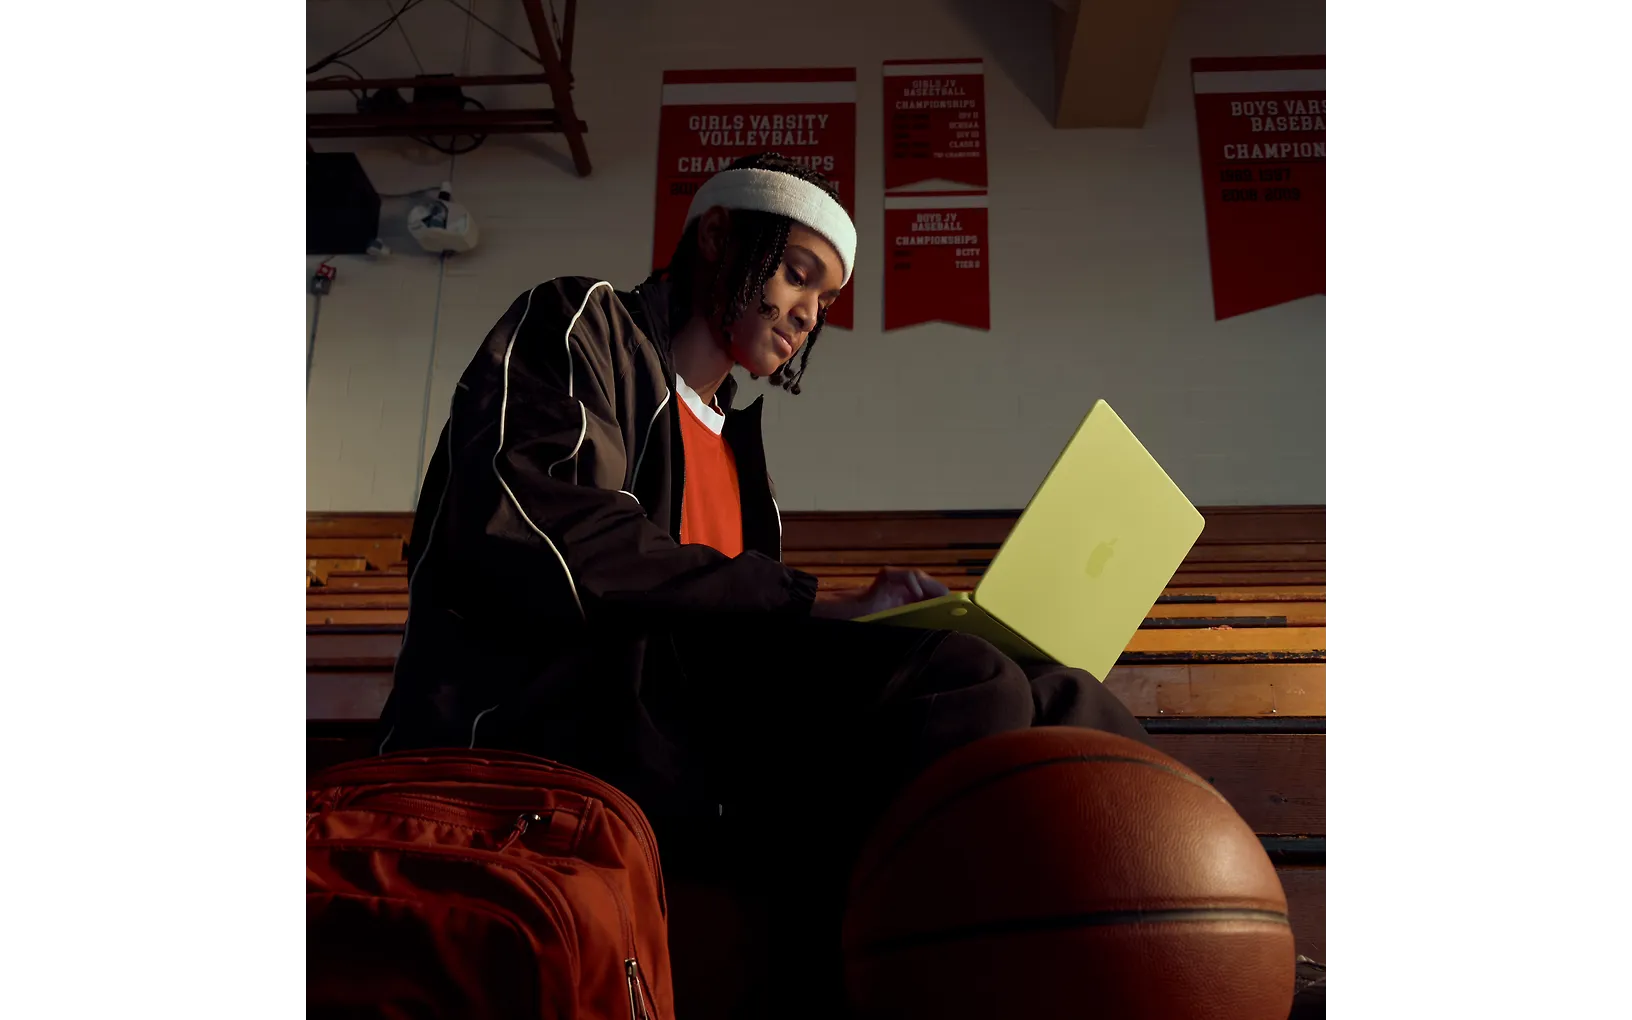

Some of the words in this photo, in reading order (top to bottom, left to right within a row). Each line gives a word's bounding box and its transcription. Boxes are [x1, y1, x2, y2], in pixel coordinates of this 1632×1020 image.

[912, 79, 942, 88] GIRLS
[944, 79, 956, 88] JV
[903, 87, 966, 97] BASKETBALL
[895, 99, 976, 110] CHAMPIONSHIPS
[1231, 101, 1279, 116] BOYS
[688, 114, 744, 131] GIRLS
[749, 113, 829, 130] VARSITY
[698, 130, 819, 147] VOLLEYBALL
[916, 212, 942, 222] BOYS
[944, 212, 957, 222] JV
[911, 222, 964, 232] BASEBALL
[895, 235, 978, 247] CHAMPIONSHIPS
